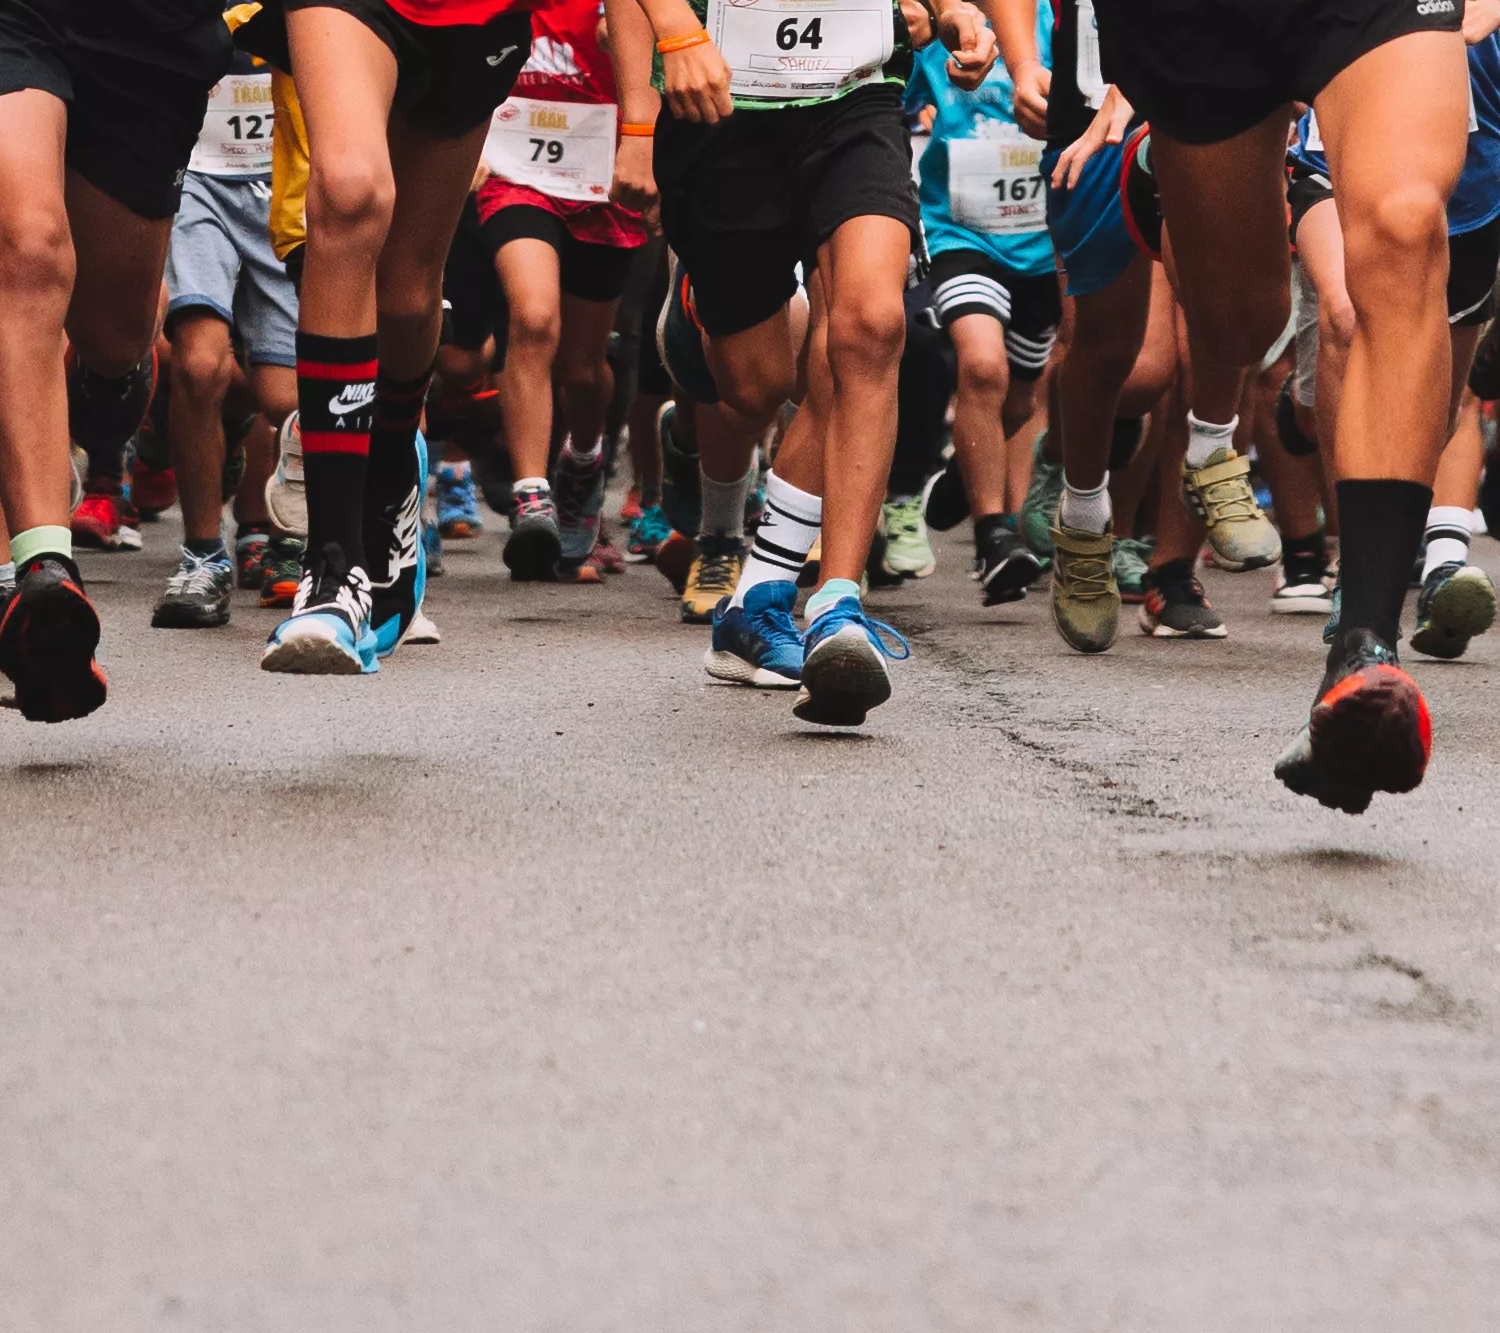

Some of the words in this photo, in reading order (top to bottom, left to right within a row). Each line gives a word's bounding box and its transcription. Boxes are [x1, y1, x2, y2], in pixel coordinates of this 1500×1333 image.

[1416, 0, 1456, 15] adidas
[775, 17, 823, 50] 64
[774, 56, 830, 72] SAMUEL
[529, 109, 570, 130] TRAIL
[529, 138, 564, 163] 79
[993, 175, 1044, 201] 167
[339, 382, 376, 401] NIKE
